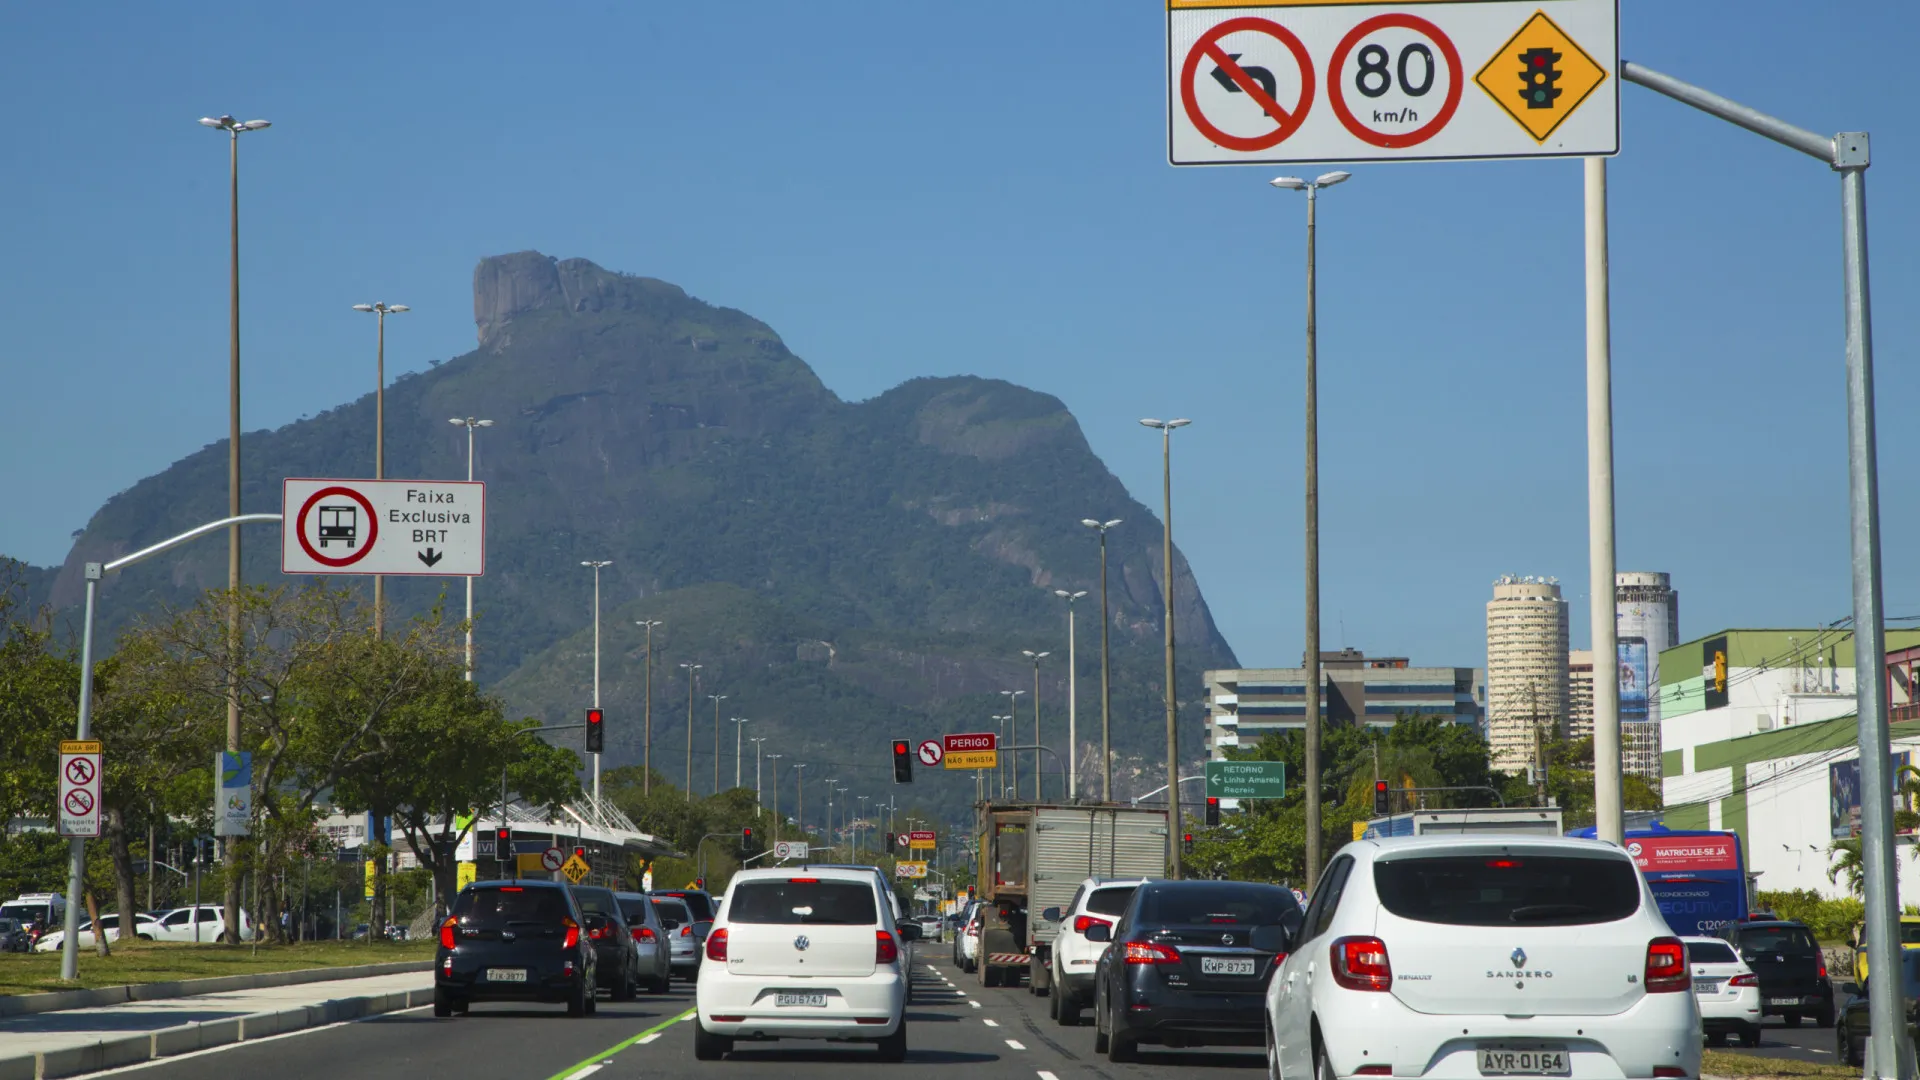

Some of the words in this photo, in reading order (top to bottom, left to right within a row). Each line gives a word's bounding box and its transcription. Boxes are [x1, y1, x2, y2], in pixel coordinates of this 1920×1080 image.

[1355, 42, 1435, 98] 80
[1373, 107, 1418, 123] km/h
[406, 489, 455, 504] Faixa
[388, 509, 471, 524] Exclusiva
[412, 529, 448, 543] BRT
[950, 737, 989, 748] PERIGO
[947, 756, 963, 764] NÃO
[966, 755, 994, 764] INSISTA
[1223, 765, 1264, 774] RETORNO
[1223, 776, 1245, 784] Linha
[1248, 776, 1280, 784] Amarela
[1223, 786, 1255, 794] Recreio
[1655, 847, 1714, 857] MATRICULE-SE
[1716, 845, 1726, 855] JÁ
[1486, 971, 1553, 979] SANDERO
